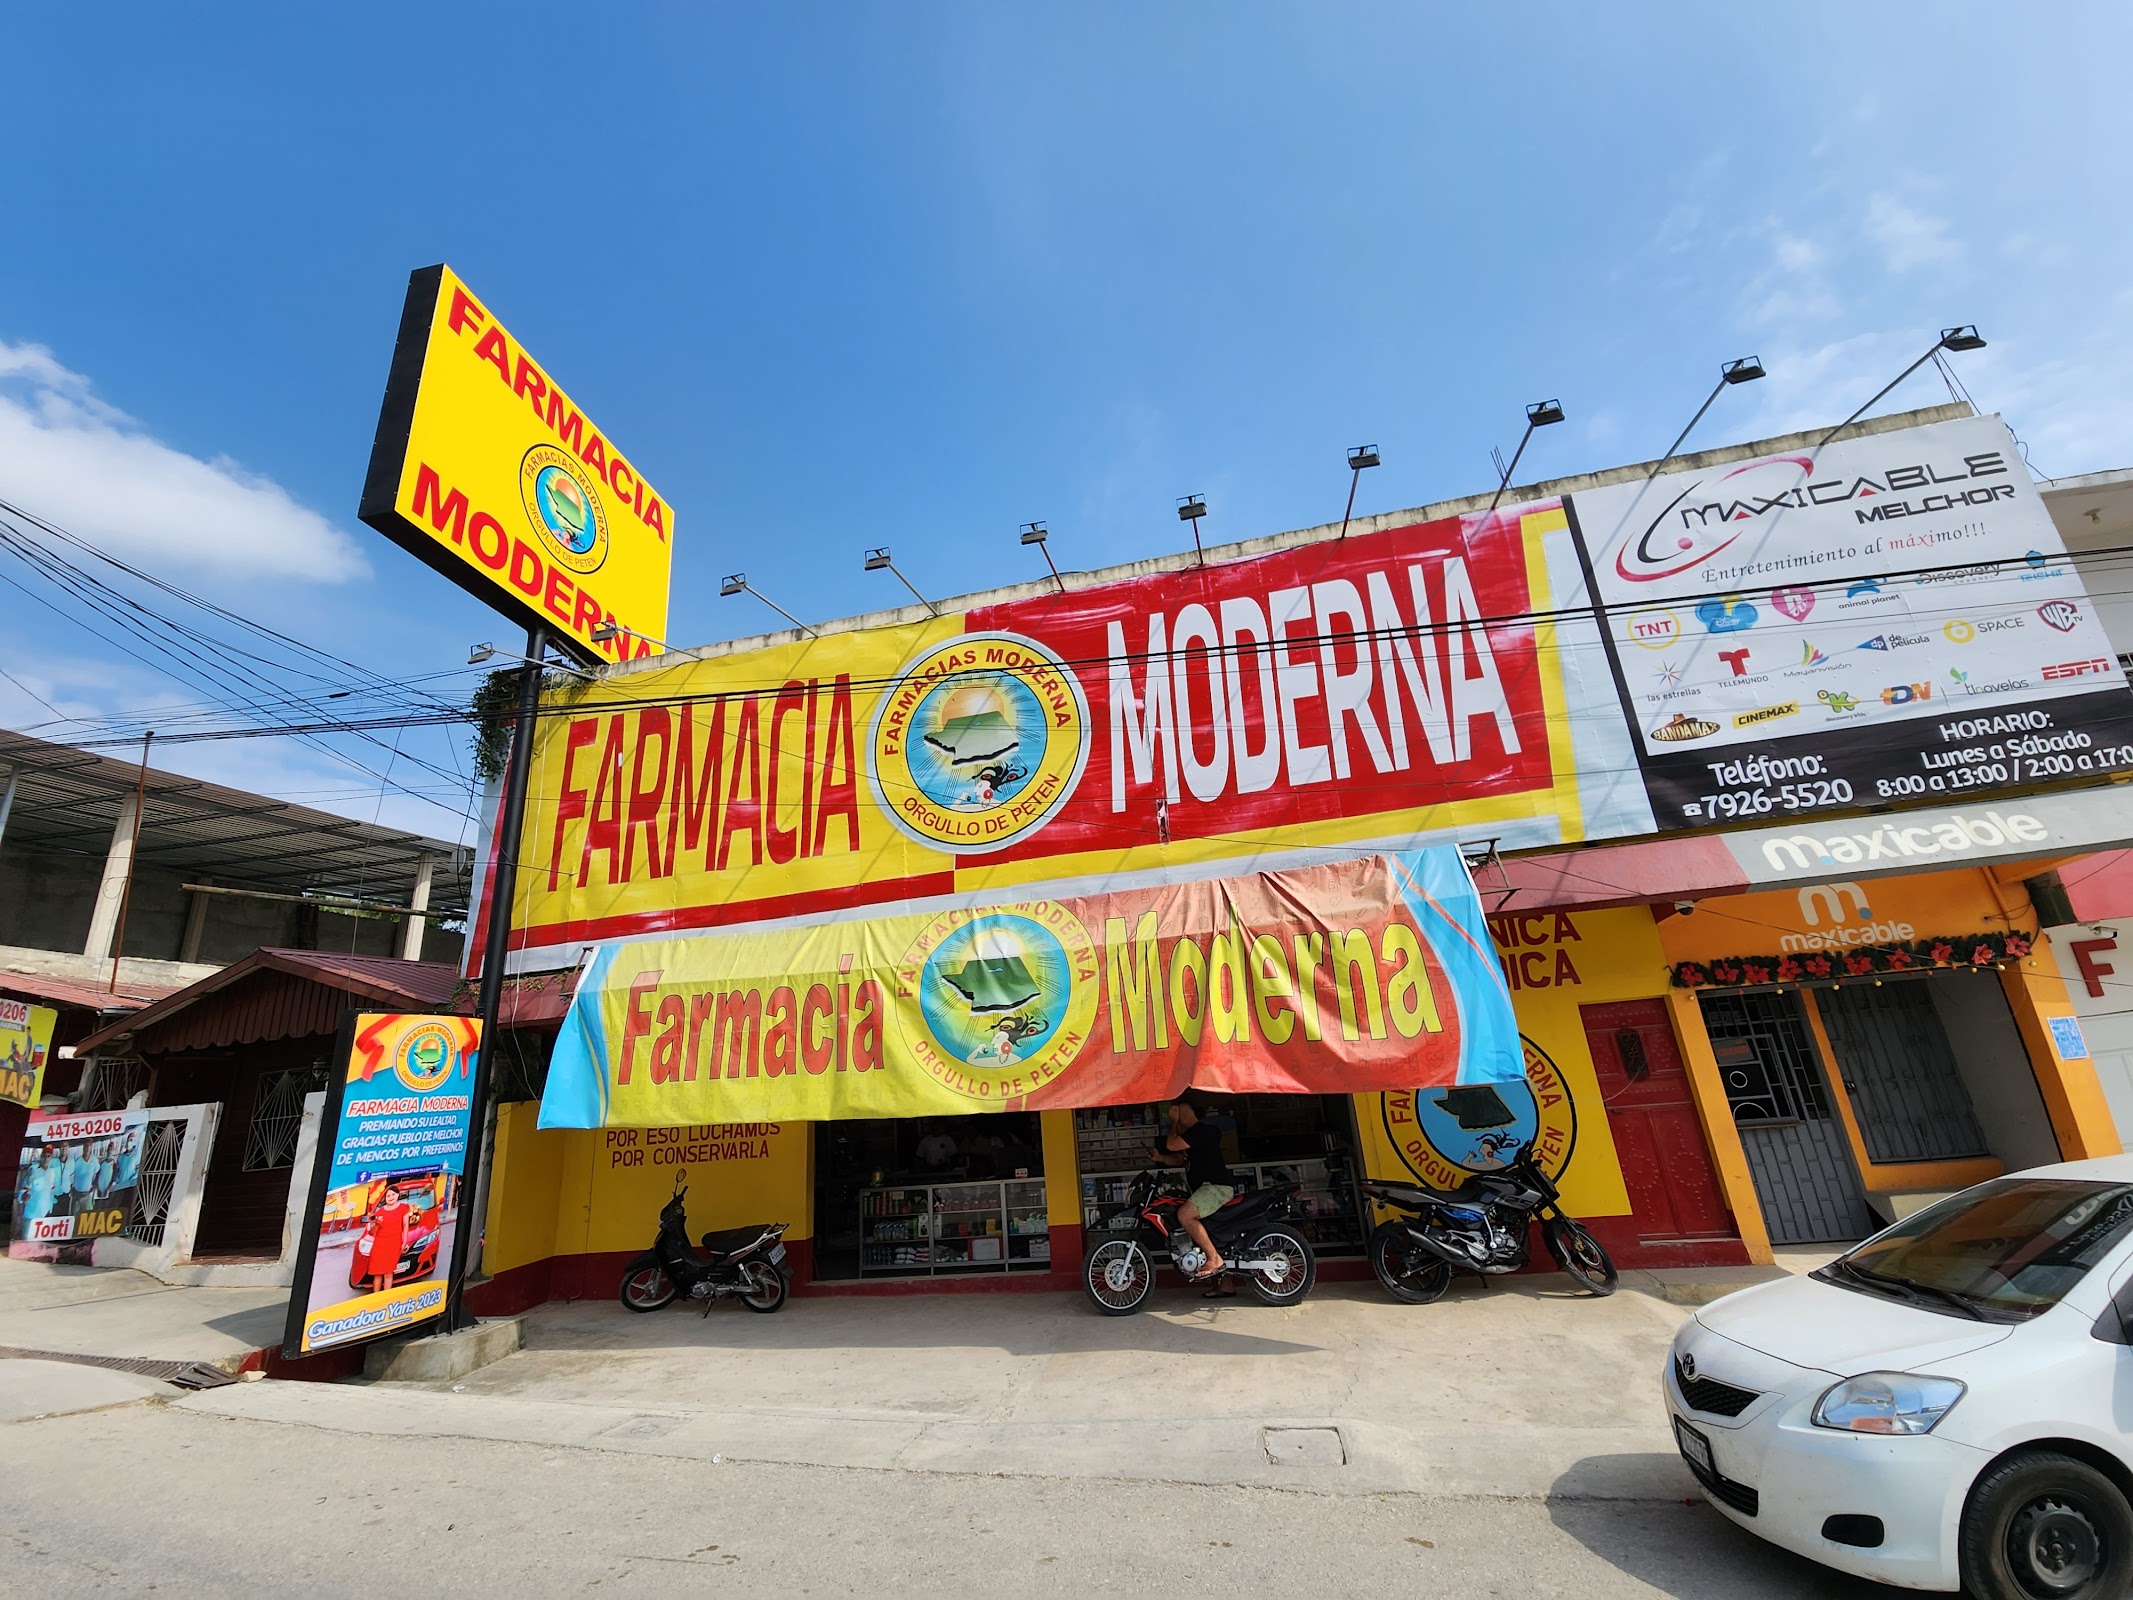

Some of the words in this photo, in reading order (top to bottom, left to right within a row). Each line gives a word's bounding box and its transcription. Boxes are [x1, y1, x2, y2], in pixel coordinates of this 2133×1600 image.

[448, 285, 665, 543] FARMACIA
[525, 451, 574, 479] FARMACIAS
[578, 474, 606, 543] MODERNA
[1681, 451, 2008, 529] MAXICABLE
[1855, 484, 2016, 524] MELCHOR
[529, 502, 560, 554] ORGULLO
[563, 551, 574, 564] DE
[575, 556, 597, 567] PETEN
[1702, 544, 1856, 583] Entretenimiento
[1865, 537, 1882, 555] al
[1888, 522, 1986, 550] máximo!!!
[1838, 599, 1870, 610] animal
[1871, 593, 1901, 607] planet
[2041, 603, 2075, 630] WB
[1634, 620, 1672, 637] TNT
[1889, 634, 1901, 642] de
[1978, 617, 2025, 633] SPACE
[1107, 556, 1522, 813] MODERNA
[1718, 675, 1769, 689] TELEMUNDO
[2041, 658, 2110, 681] ESPN
[885, 650, 976, 756] FARMACIAS
[985, 648, 1072, 728] MODERNA
[1647, 693, 1661, 702] las
[1663, 687, 1702, 700] estrellas
[1738, 704, 1795, 725] CINEMAX
[1825, 714, 1854, 723] discovery
[1939, 710, 2054, 742] HORARIO:
[1653, 721, 1719, 741] BANDAMAX
[1921, 746, 1986, 770] Lunes
[1990, 745, 2005, 760] a
[2006, 730, 2091, 758] Sábado
[547, 673, 860, 892] FARMACIA
[1707, 752, 1828, 787] Teléfono:
[1876, 775, 1925, 798] 8:00
[1929, 775, 1945, 792] a
[1947, 763, 2008, 789] 13:00
[2025, 755, 2074, 778] 2:00
[2077, 754, 2093, 770] a
[903, 797, 980, 836] ORGULLO
[985, 814, 1010, 834] DE
[1011, 773, 1061, 823] PETEN
[1701, 778, 1854, 820] 7926-5520
[1762, 811, 2049, 871] maxicable
[898, 905, 1000, 998] FARMACIA
[1015, 901, 1096, 983] MODERNA
[1780, 920, 1916, 952] maxicable
[1105, 900, 1443, 1053] Moderna
[2070, 938, 2117, 998] F
[399, 1026, 435, 1057] FARMACIAS
[915, 1040, 990, 1097] ORGULLO
[1001, 1077, 1023, 1097] DE
[1029, 1031, 1082, 1085] PETEN
[347, 1097, 418, 1117] FARMACIA
[421, 1096, 468, 1112] MODERNA
[46, 1117, 122, 1139] 4478-0206
[342, 1135, 387, 1149] GRACIAS
[387, 1132, 422, 1145] PUEBLO
[422, 1131, 433, 1141] DE
[433, 1128, 464, 1140] MELCHOR
[359, 1118, 417, 1132] PREMIANDO
[418, 1117, 429, 1127] SU
[606, 1129, 638, 1148] POR
[646, 1127, 680, 1146] ESO
[689, 1123, 781, 1142] LUCHAMOS
[336, 1153, 353, 1166] DE
[355, 1148, 400, 1163] MENCOS
[401, 1146, 419, 1158] POR
[421, 1142, 464, 1155] PREFERIRNOS
[611, 1149, 644, 1168] POR
[653, 1139, 769, 1166] CONSERVARLA
[34, 1219, 70, 1239] Torti
[77, 1209, 124, 1235] MAC
[309, 1309, 385, 1338] Ganadora
[388, 1298, 415, 1318] Yaris
[416, 1288, 442, 1311] 2023
